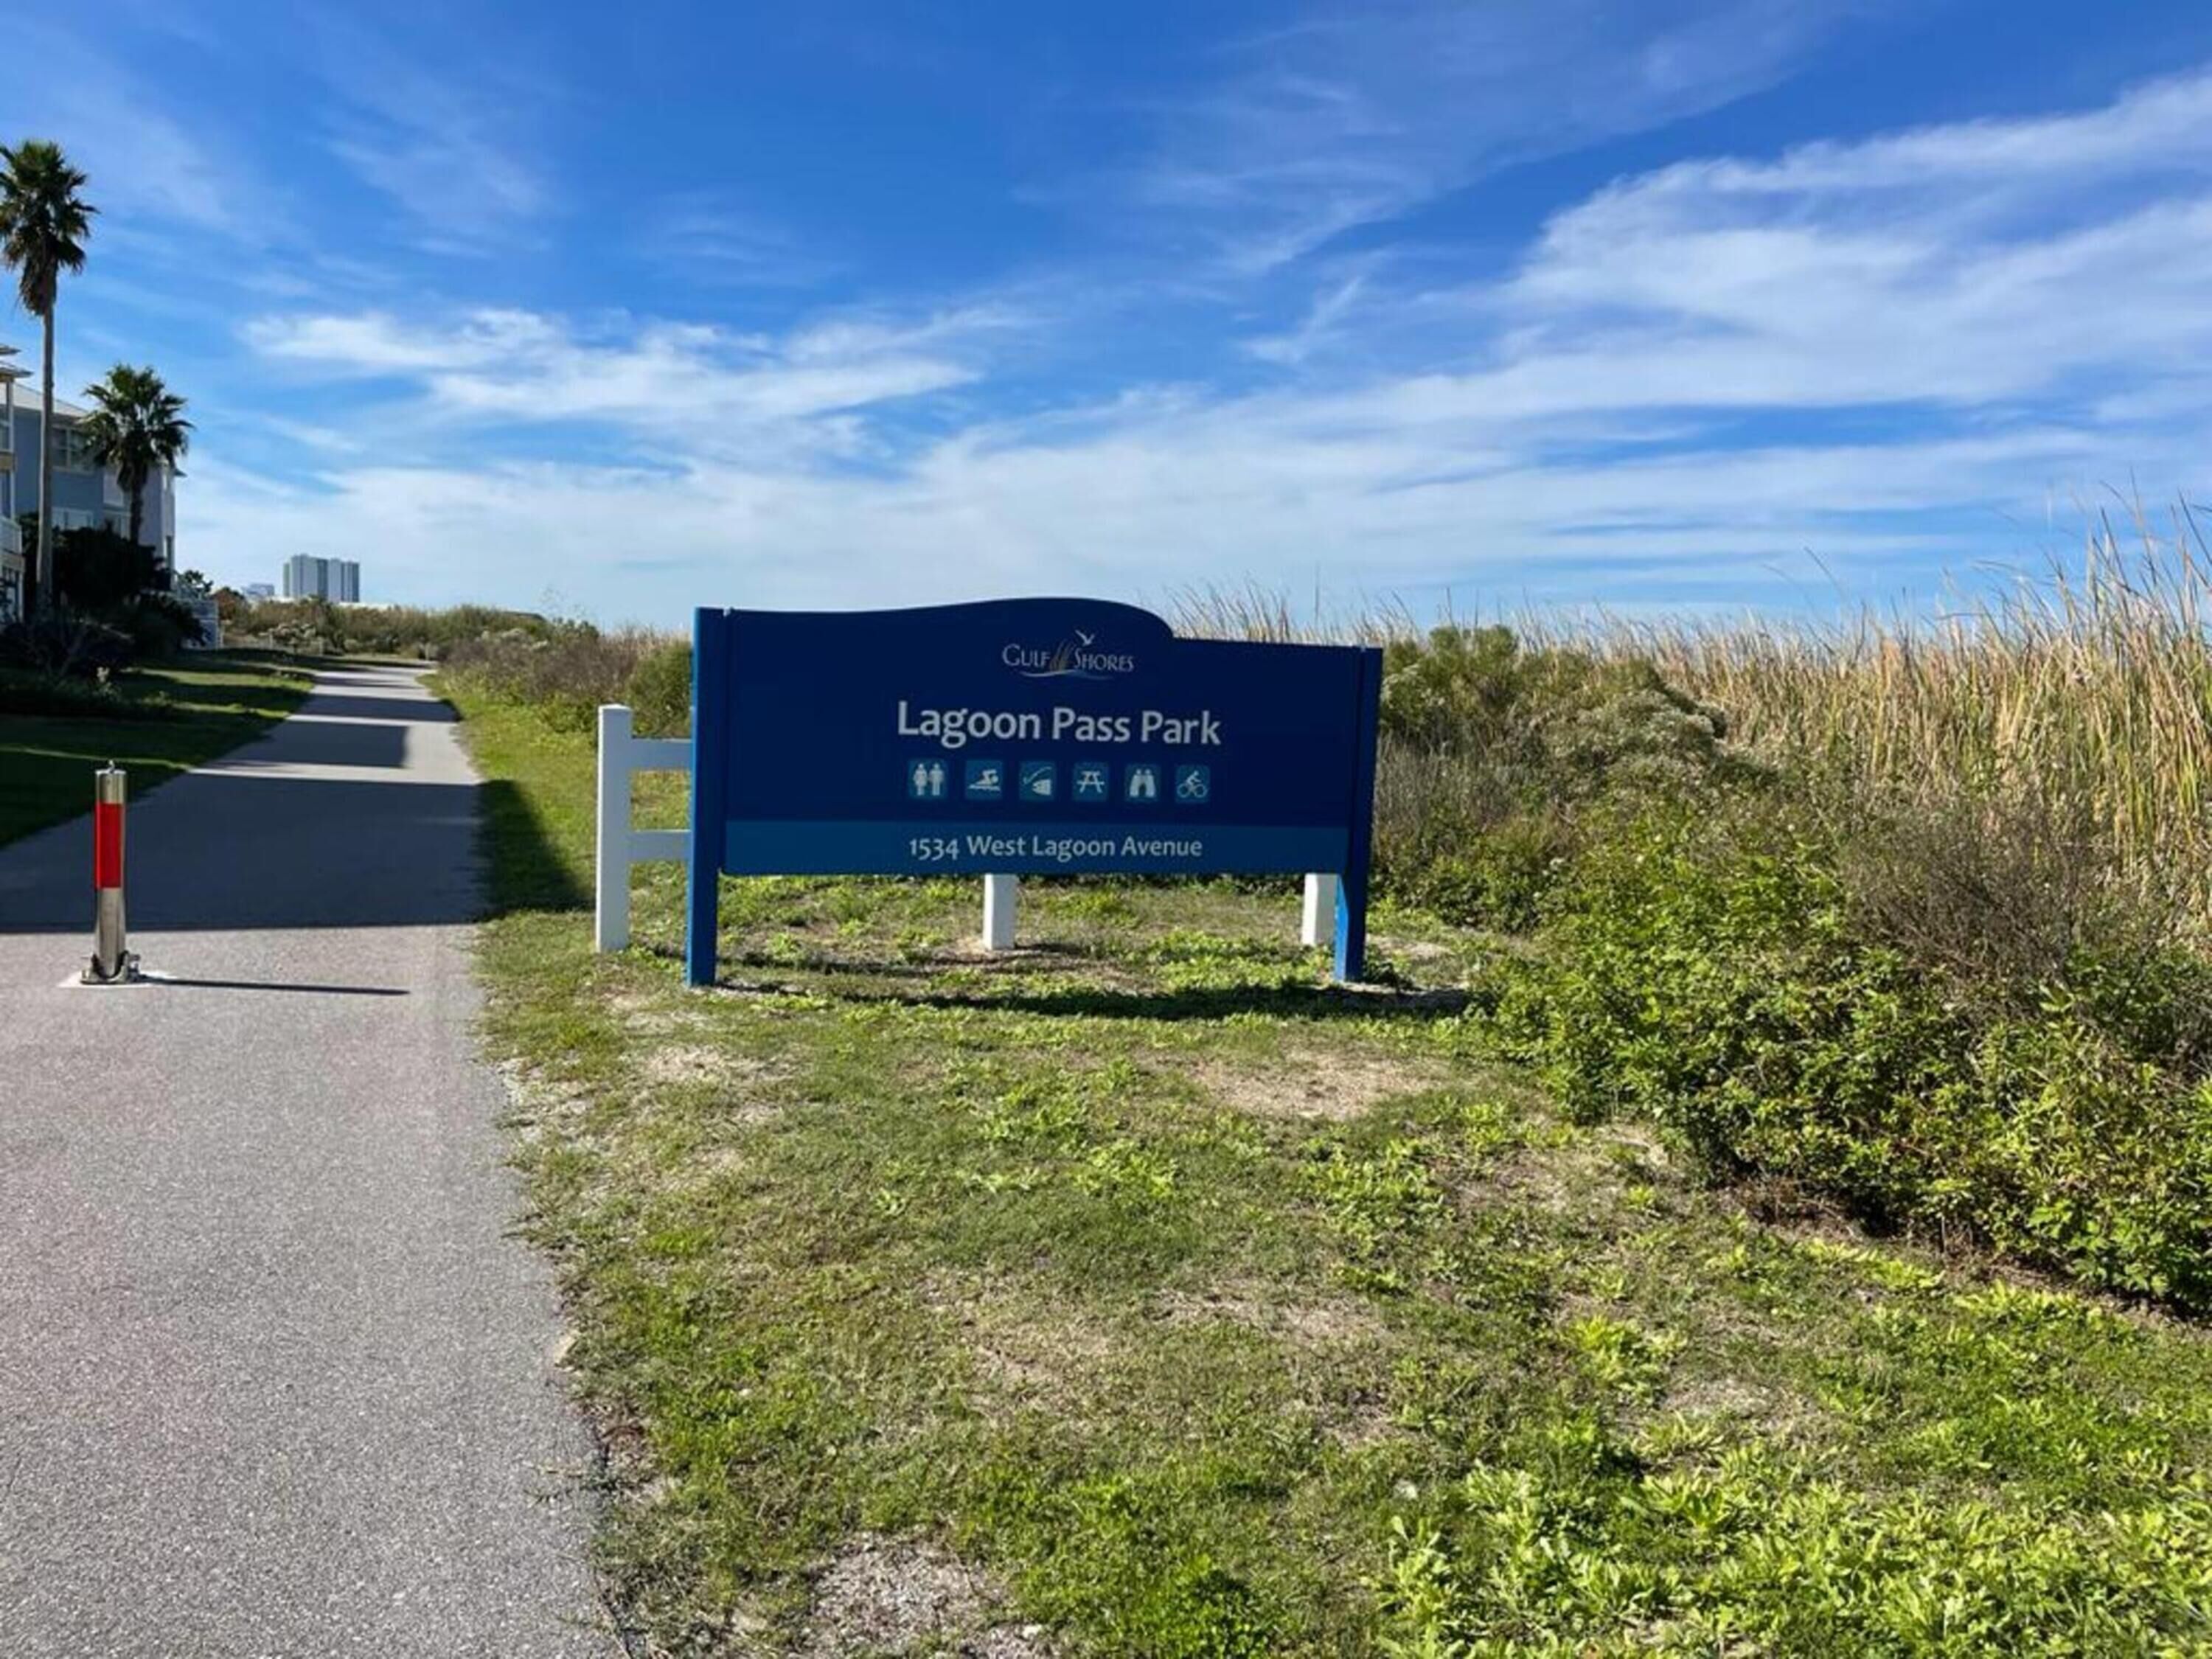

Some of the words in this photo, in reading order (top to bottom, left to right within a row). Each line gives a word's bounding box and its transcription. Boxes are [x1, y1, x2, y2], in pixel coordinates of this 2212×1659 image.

[1002, 644, 1051, 668] GULF
[1074, 649, 1134, 672] SHORES
[897, 700, 1040, 748] Lagoon
[1052, 707, 1130, 742] Pass
[1141, 711, 1222, 745] Park
[909, 838, 959, 860] 1534
[967, 835, 1026, 856] West
[1033, 837, 1115, 860] Lagoon
[1121, 837, 1203, 857] Avenue
